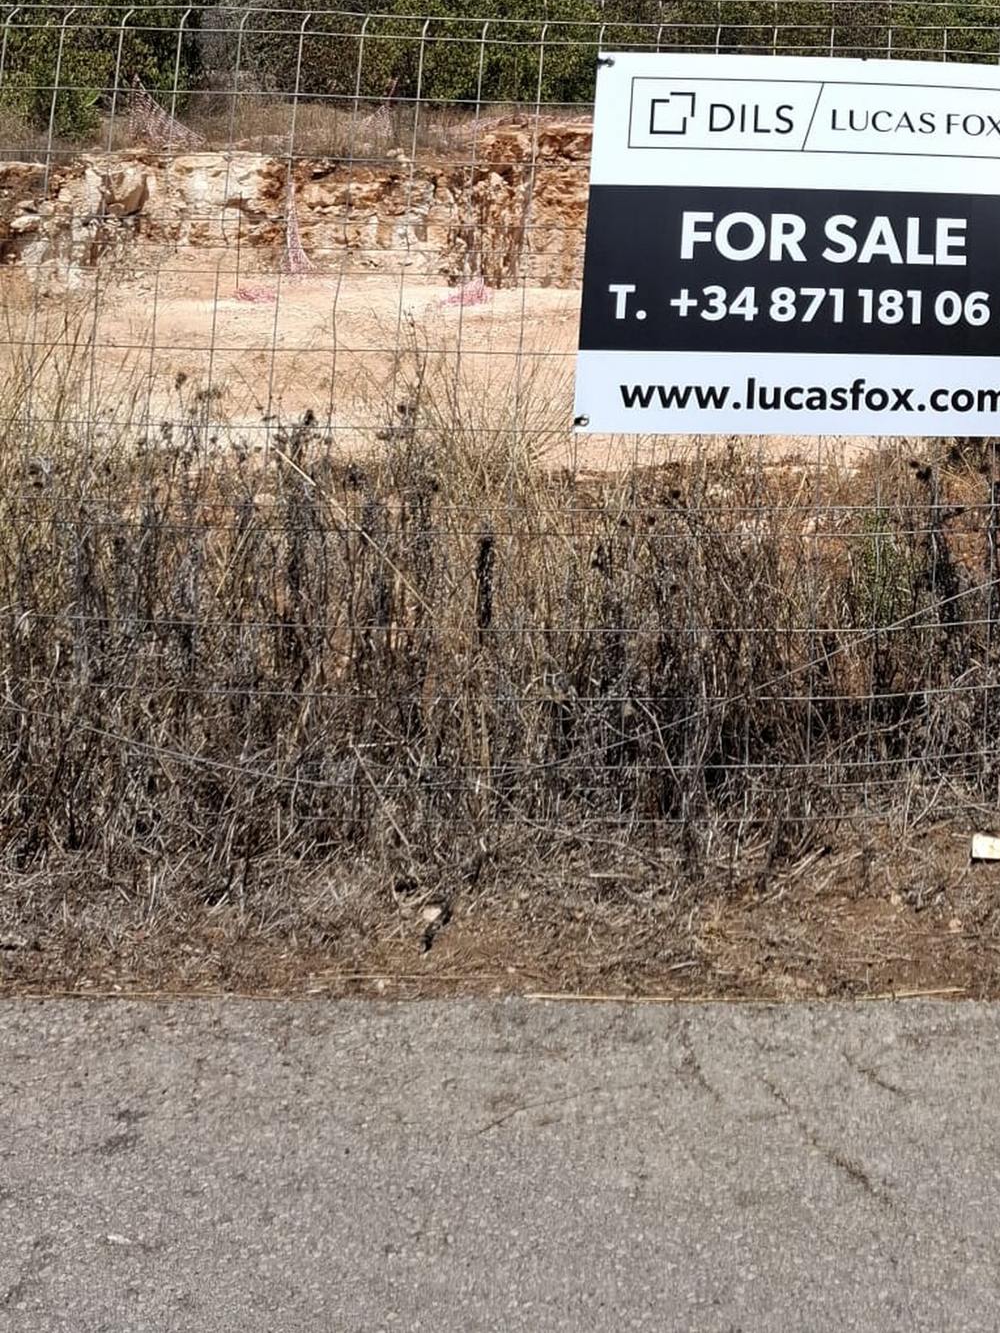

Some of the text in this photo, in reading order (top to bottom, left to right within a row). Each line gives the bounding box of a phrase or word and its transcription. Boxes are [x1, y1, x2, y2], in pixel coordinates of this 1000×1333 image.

[709, 104, 794, 134] DILS
[831, 109, 936, 134] LUCAS
[681, 212, 966, 265] FOR SALE
[609, 285, 646, 319] T.
[671, 286, 758, 321] +34
[770, 287, 844, 322] 871
[859, 289, 921, 324] 181
[935, 291, 990, 325] 06
